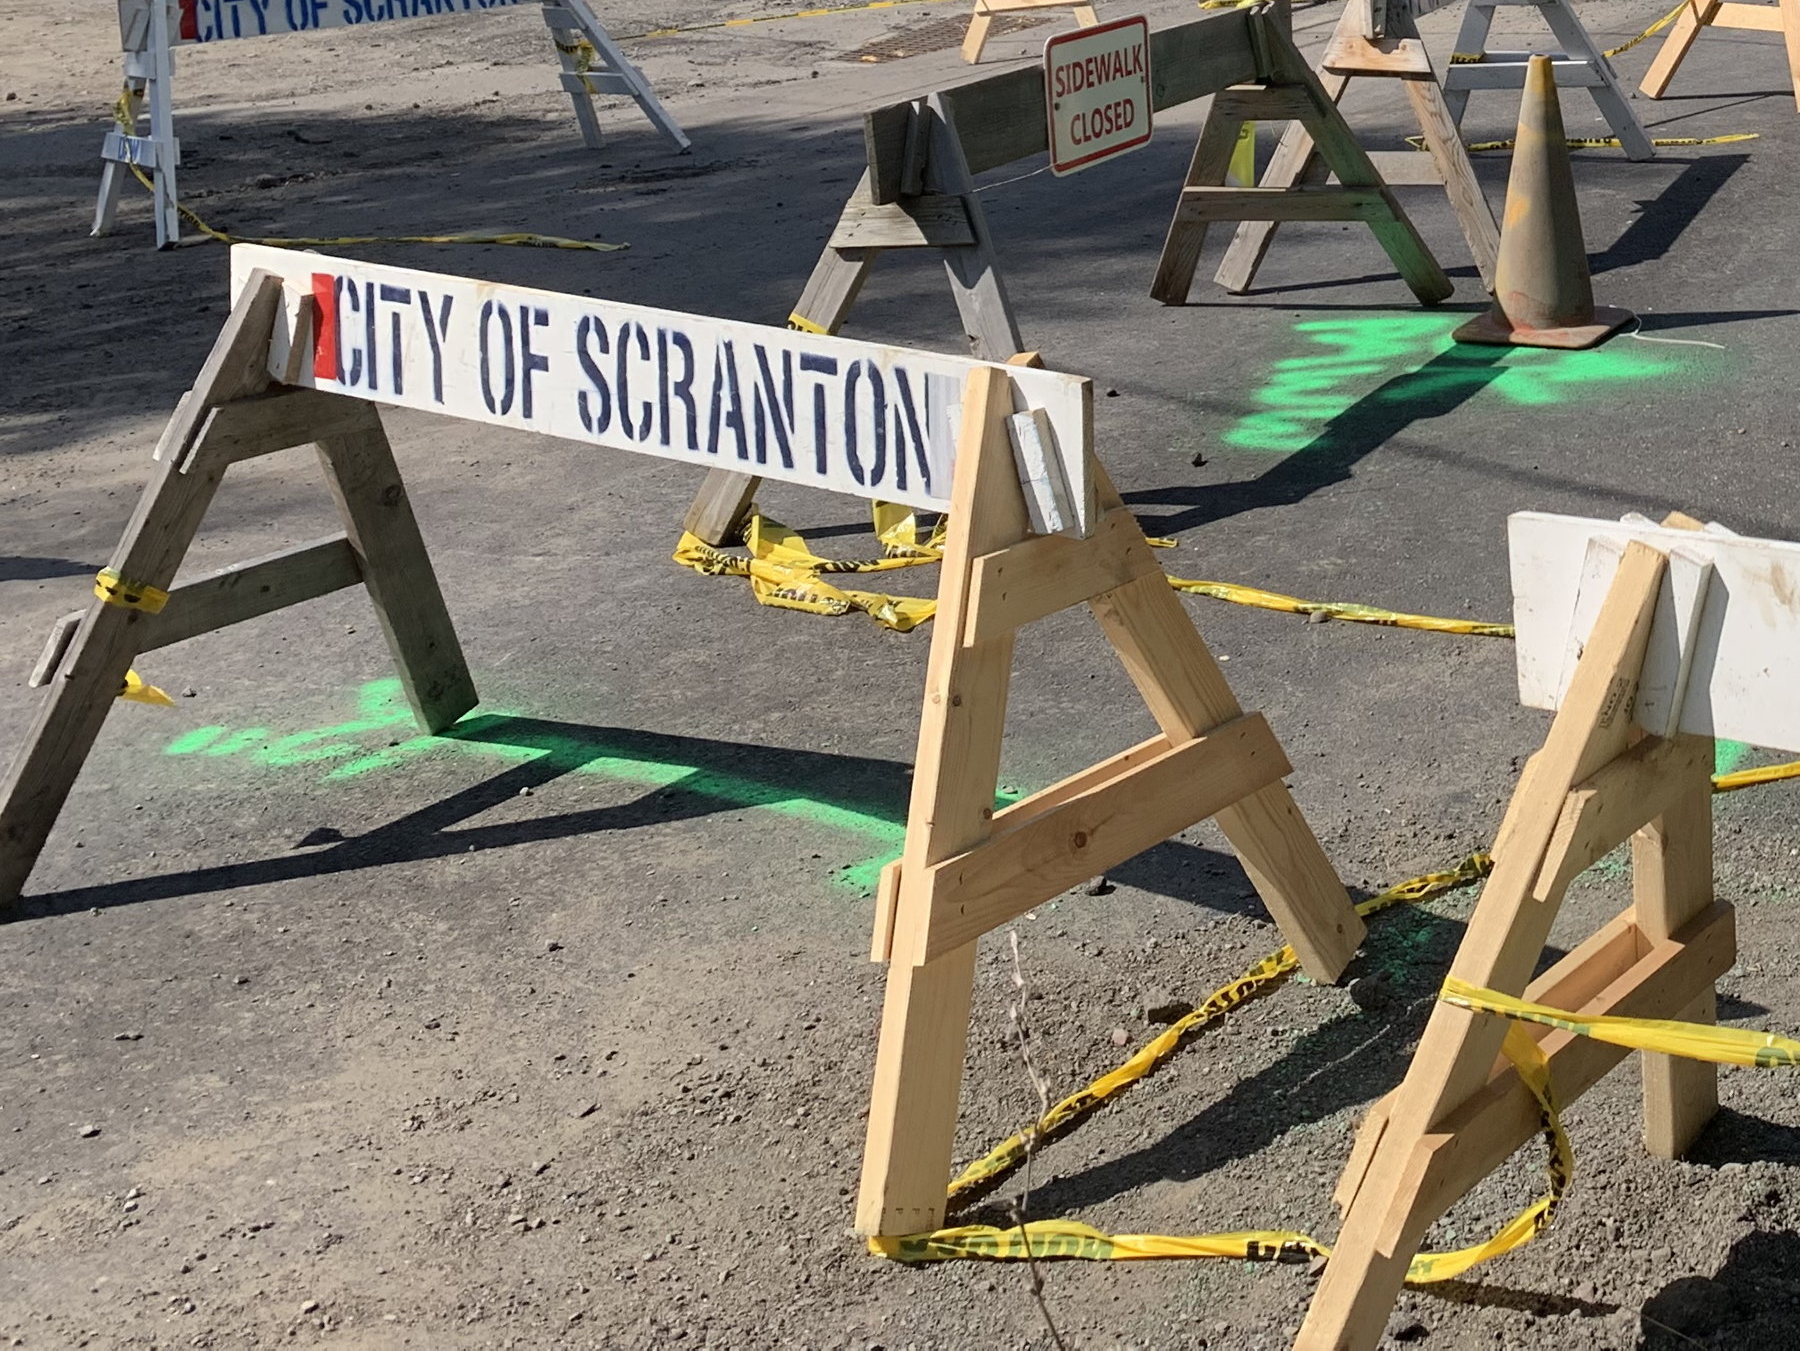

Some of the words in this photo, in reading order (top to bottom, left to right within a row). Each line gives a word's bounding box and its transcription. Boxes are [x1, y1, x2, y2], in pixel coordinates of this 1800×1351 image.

[1055, 44, 1144, 98] SIDEWALK
[1071, 98, 1136, 146] CLOSED
[333, 274, 454, 406] CITY
[479, 298, 550, 419] OF
[577, 314, 931, 492] SCRANTON
